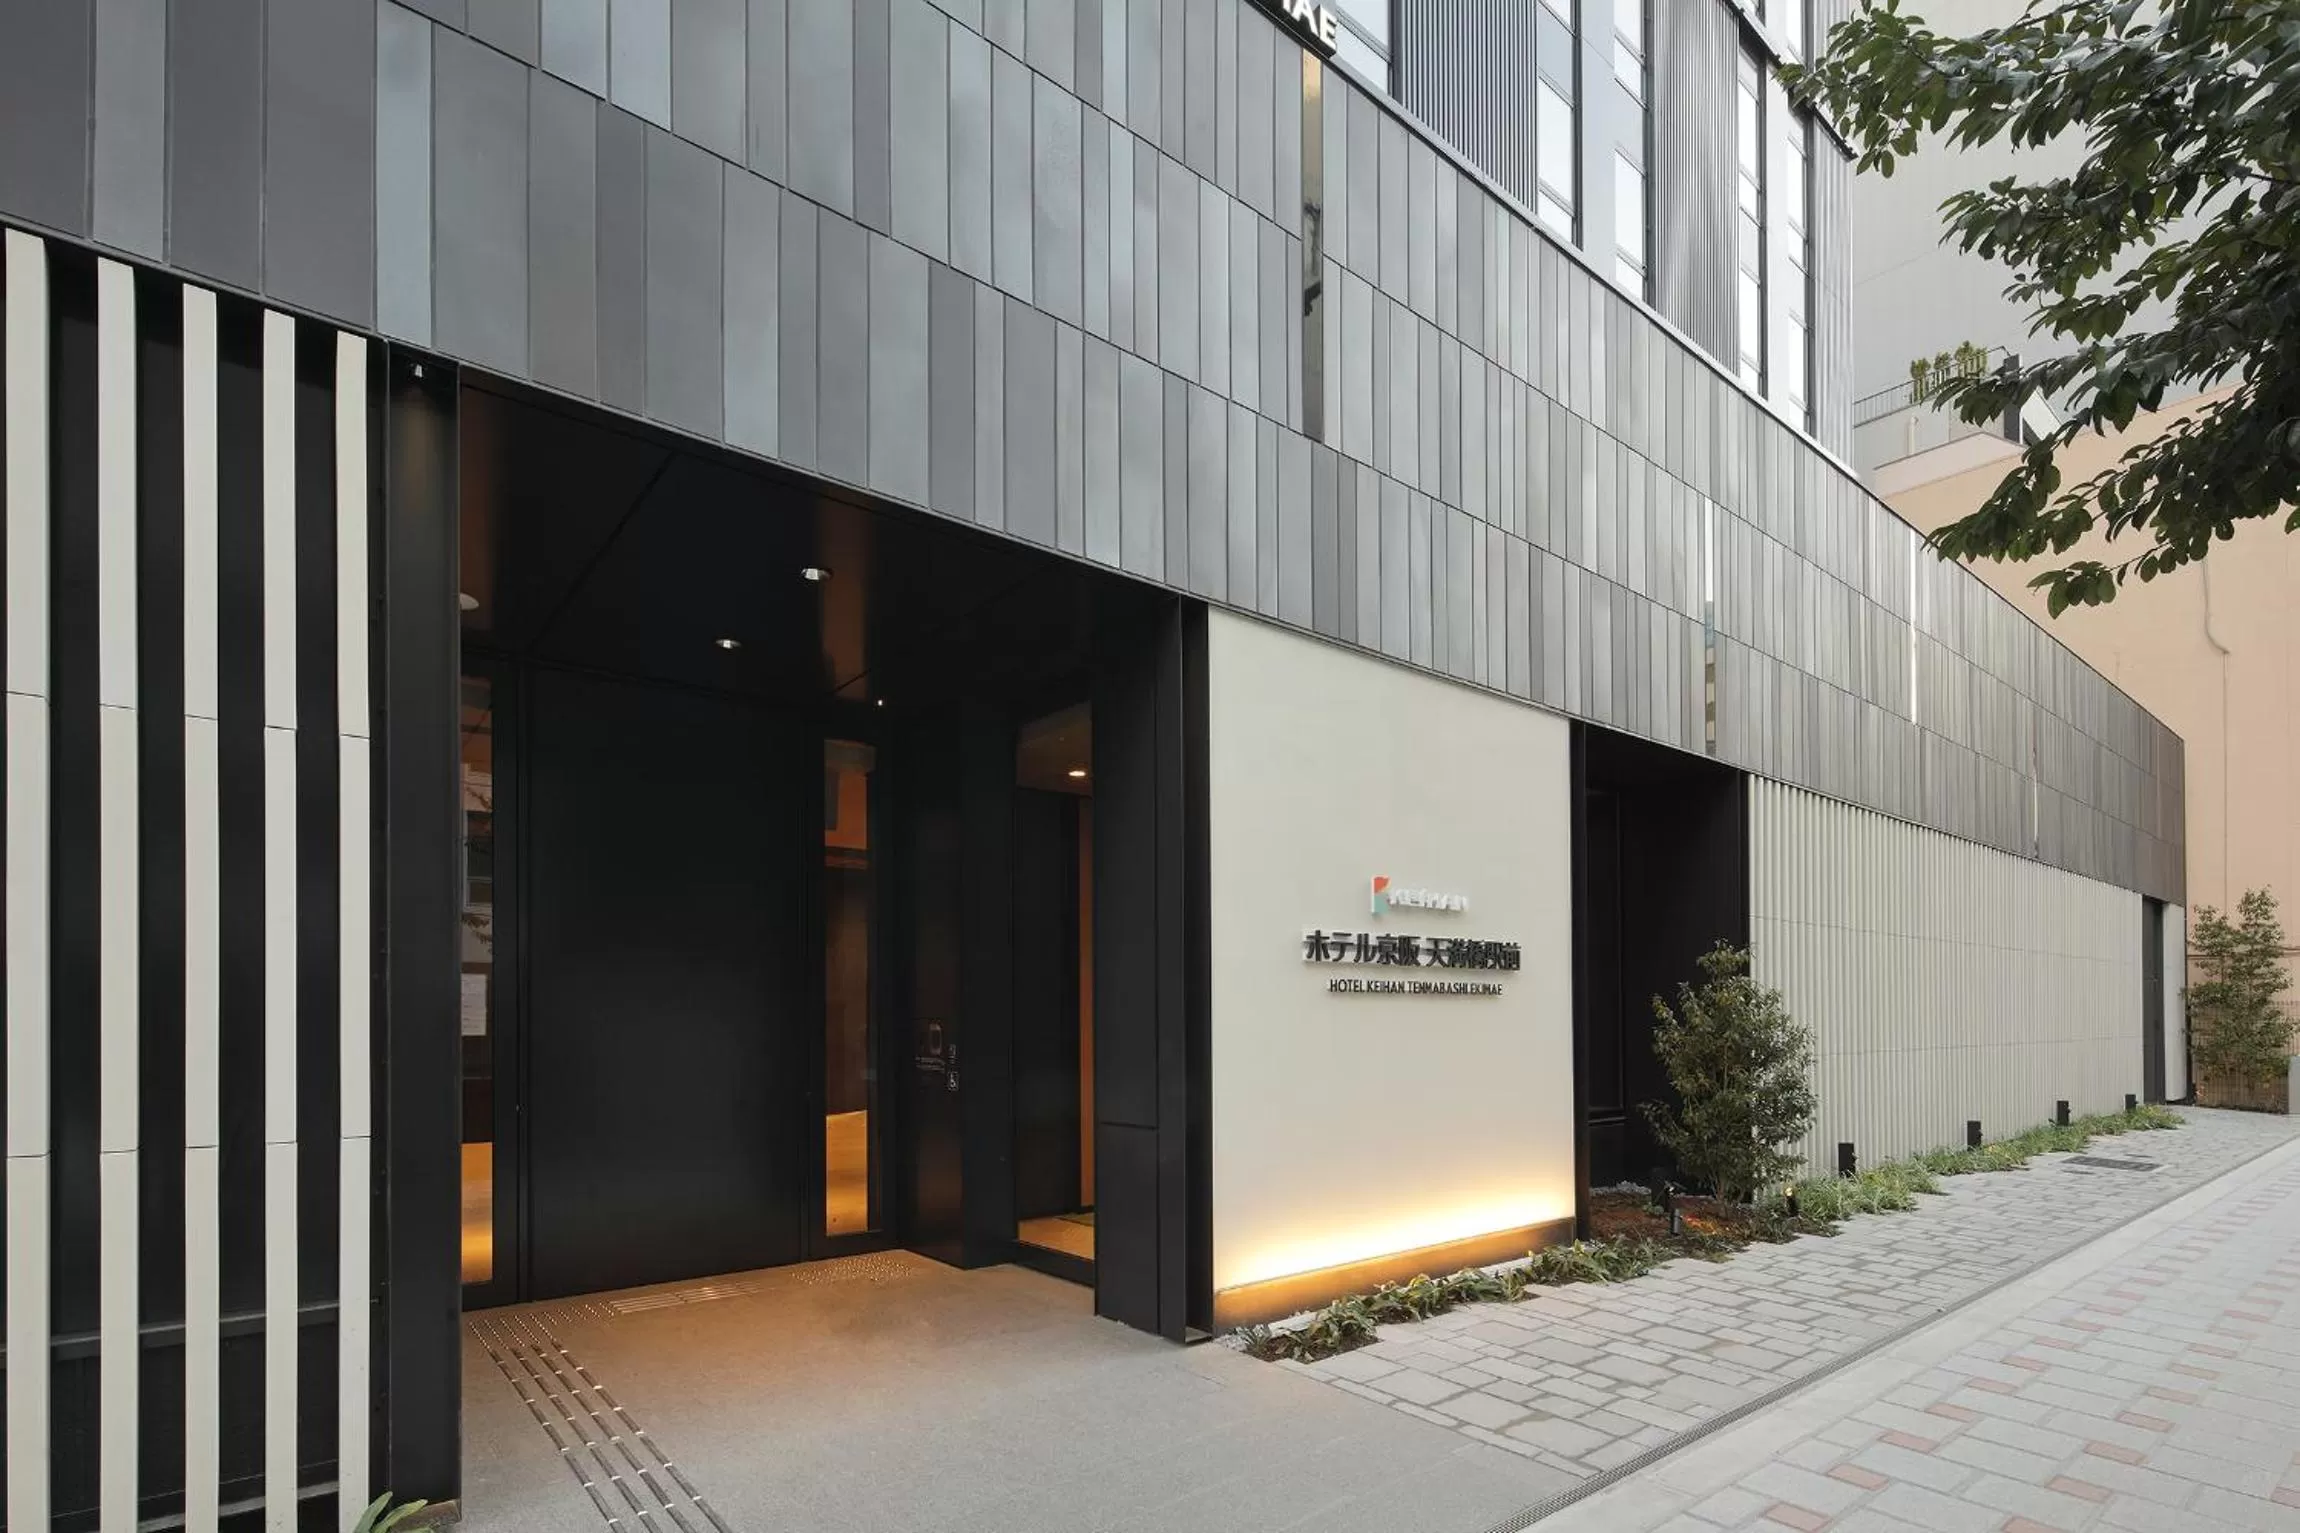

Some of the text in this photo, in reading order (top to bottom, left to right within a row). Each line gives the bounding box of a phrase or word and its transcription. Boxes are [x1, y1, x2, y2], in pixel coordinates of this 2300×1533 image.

[1282, 0, 1337, 52] AE
[1306, 930, 1420, 966] ホテル京阪
[1329, 978, 1503, 996] HOTEL KEIHAN TENMABASHI EKIMAE
